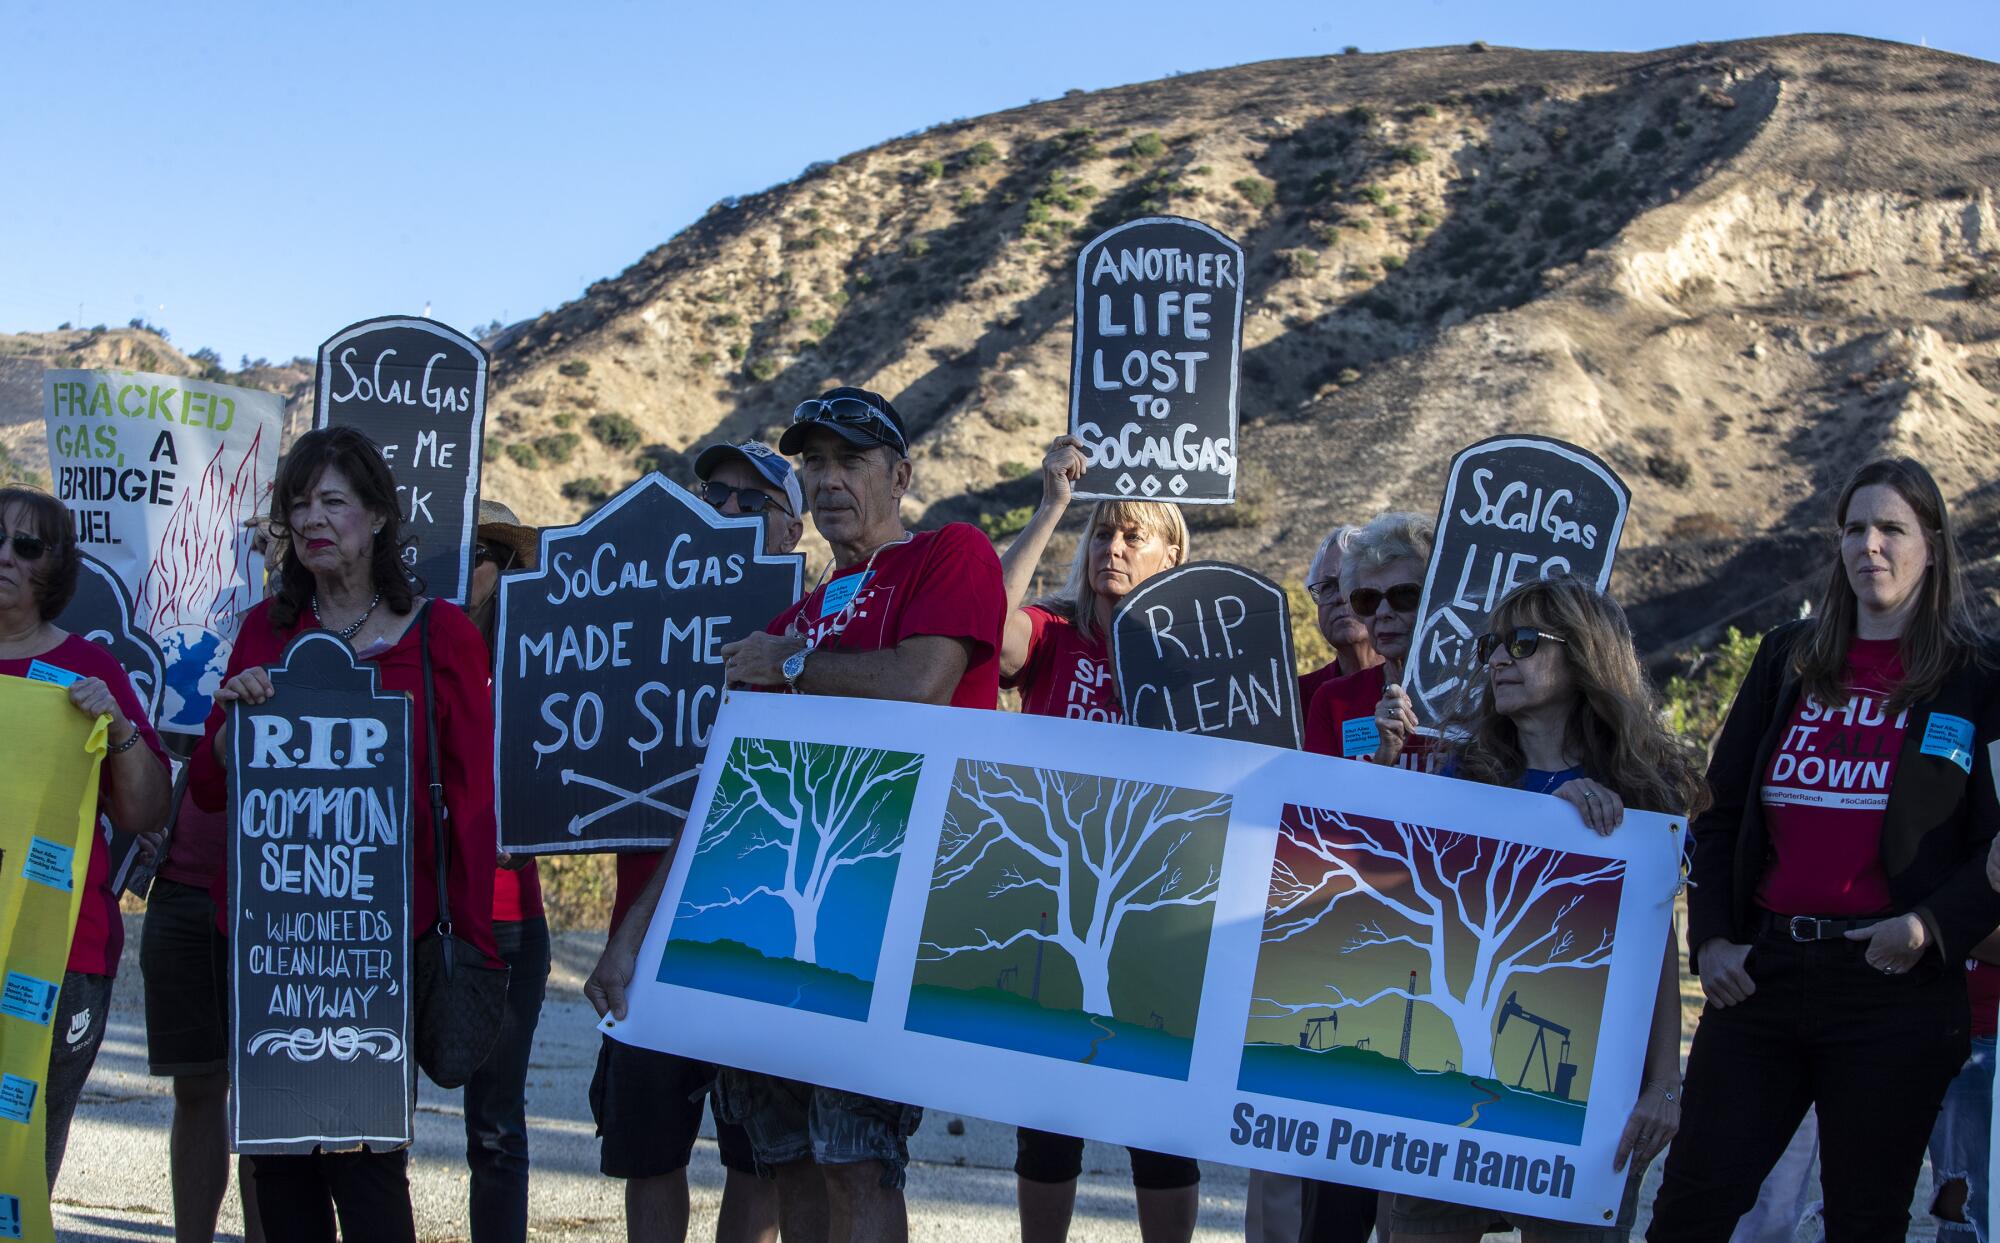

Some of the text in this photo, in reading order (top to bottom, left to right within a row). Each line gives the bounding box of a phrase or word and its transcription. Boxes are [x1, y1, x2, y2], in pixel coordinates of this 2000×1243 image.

[1092, 246, 1236, 288] ANOTHER
[1099, 291, 1212, 341] LIFE
[1093, 349, 1210, 394] LOST
[53, 382, 236, 432] FRACKED
[1129, 394, 1171, 420] TO
[56, 424, 178, 467] GAS, A
[413, 430, 457, 468] ME
[59, 466, 177, 506] BRIDGE
[69, 509, 122, 545] UEL
[520, 615, 732, 679] MADE ME
[1145, 595, 1247, 660] R.I.P.
[532, 681, 717, 756] SO SIC
[1132, 657, 1282, 734] CLEAN
[248, 715, 389, 770] R.I.P.
[1782, 725, 1892, 759] IT. ALL
[1772, 754, 1890, 789] DOWN
[242, 786, 398, 846] COMMON
[260, 842, 378, 902] SENSE
[71, 1007, 91, 1032] NIKE
[1229, 1102, 1577, 1200] Save Porter Ranch
